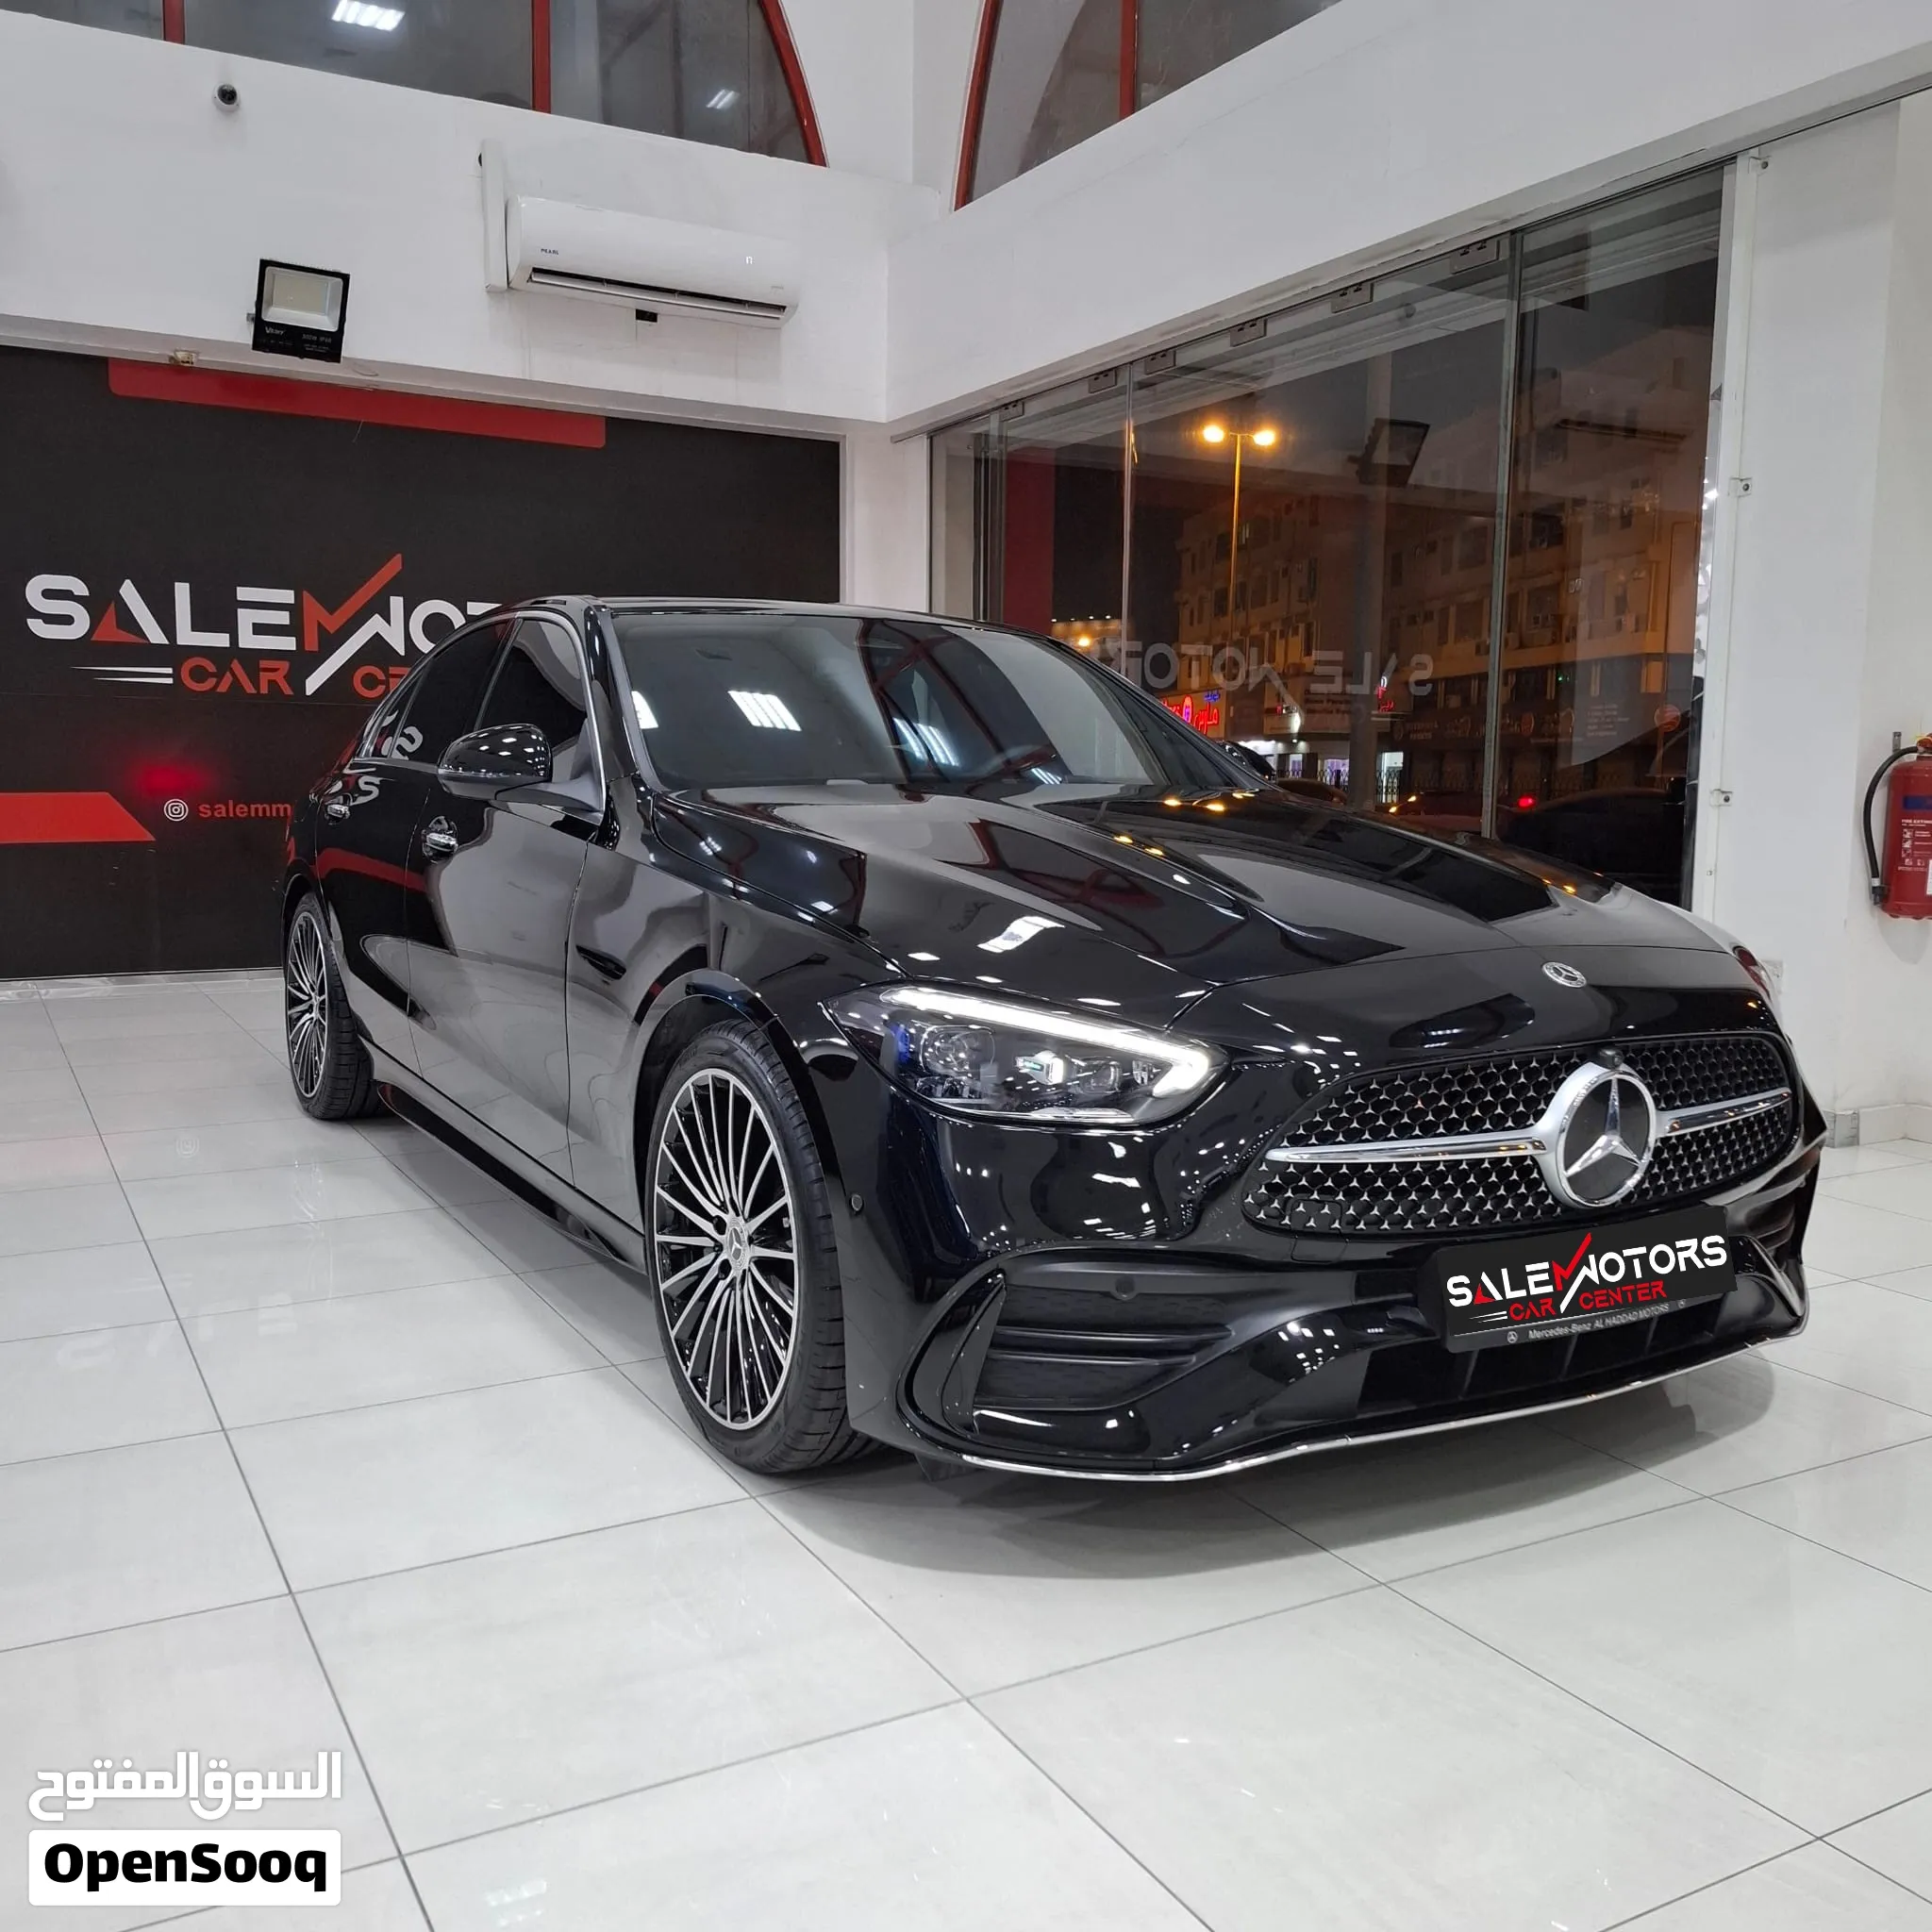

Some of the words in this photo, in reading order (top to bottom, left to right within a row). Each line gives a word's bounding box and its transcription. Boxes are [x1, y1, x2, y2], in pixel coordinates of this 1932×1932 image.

[180, 657, 294, 695] CAR
[1509, 1297, 1556, 1321] CAR
[1578, 1280, 1667, 1310] CENTER
[1528, 1322, 1591, 1340] Mercedes-Benz
